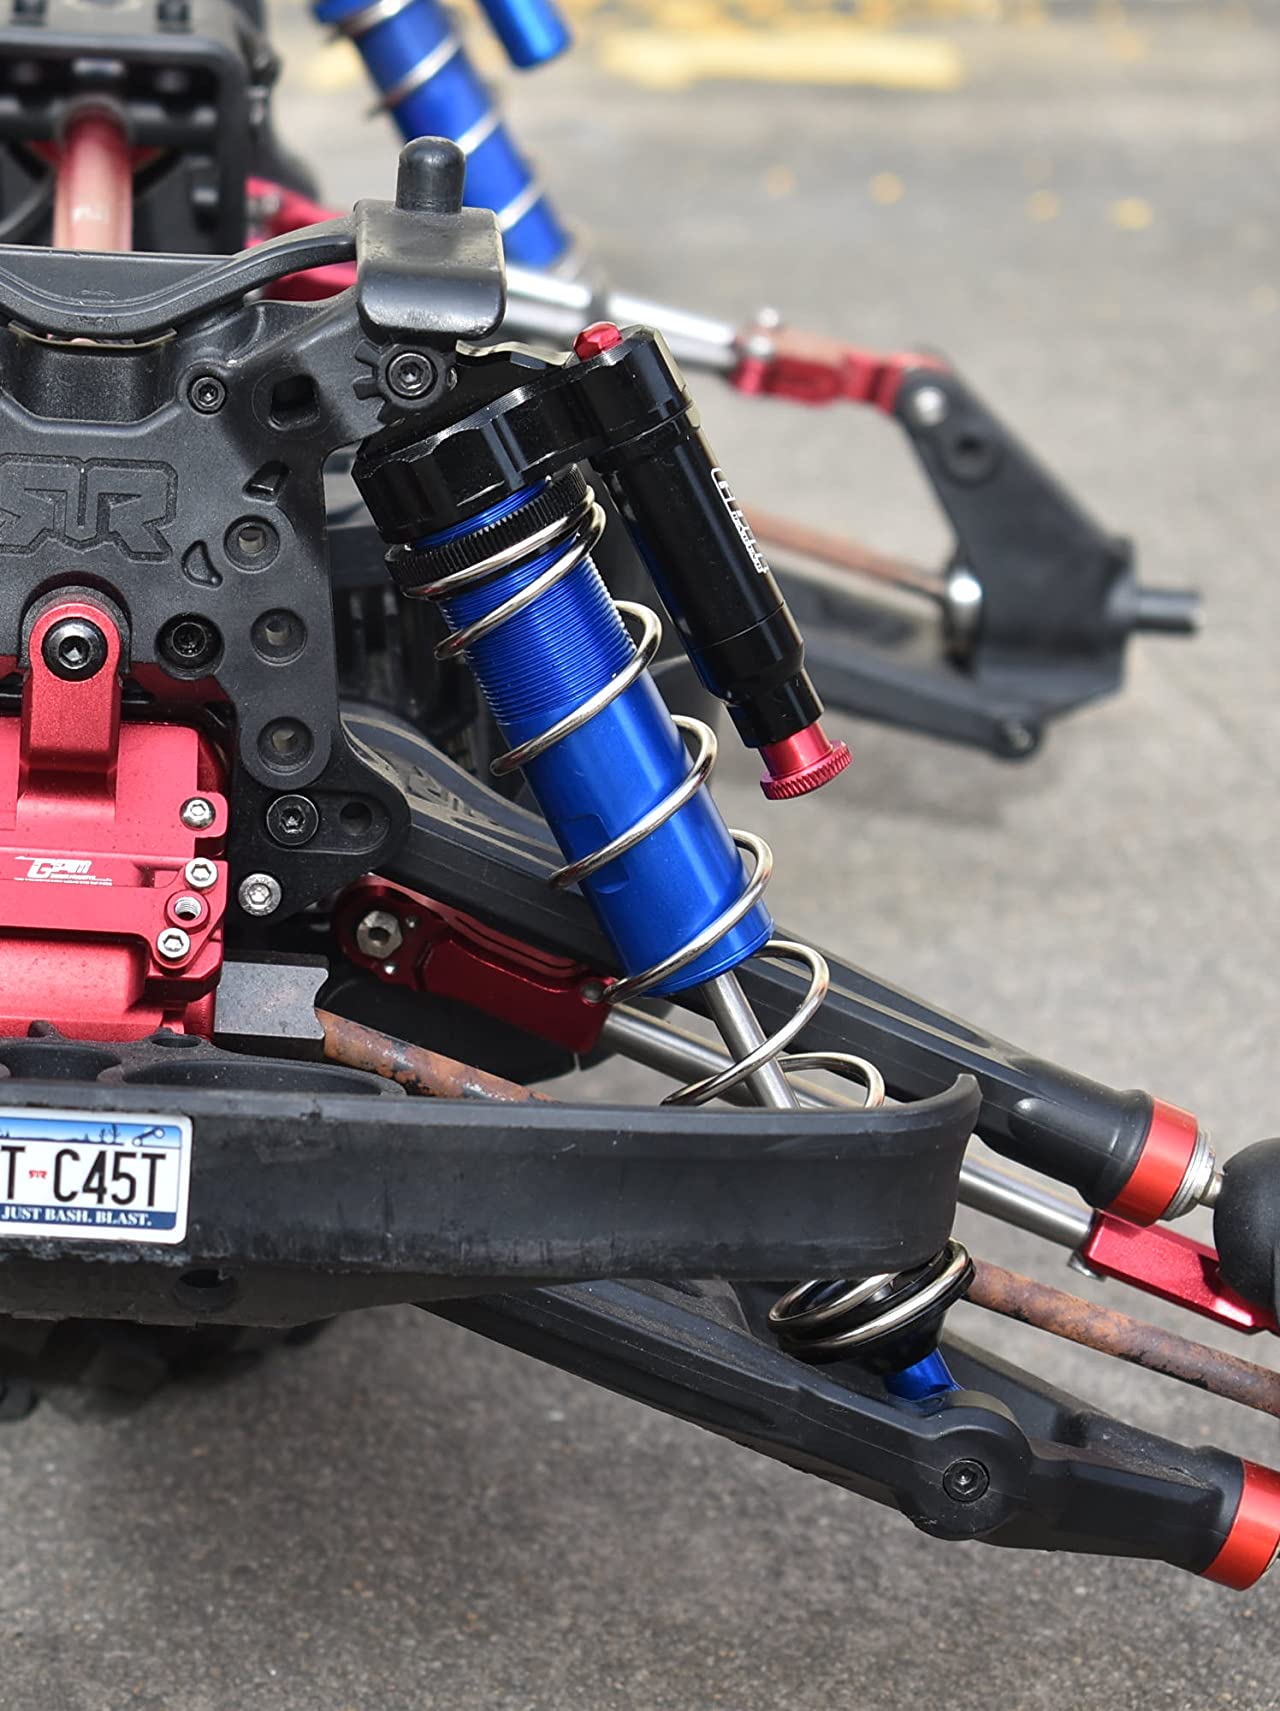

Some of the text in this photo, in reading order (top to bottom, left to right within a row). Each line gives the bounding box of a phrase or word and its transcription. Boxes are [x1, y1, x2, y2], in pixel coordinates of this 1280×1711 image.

[53, 1149, 167, 1207] C45T
[1, 1205, 42, 1221] JUST
[44, 1207, 93, 1224] BASH.
[95, 1210, 153, 1227] BLAST.
